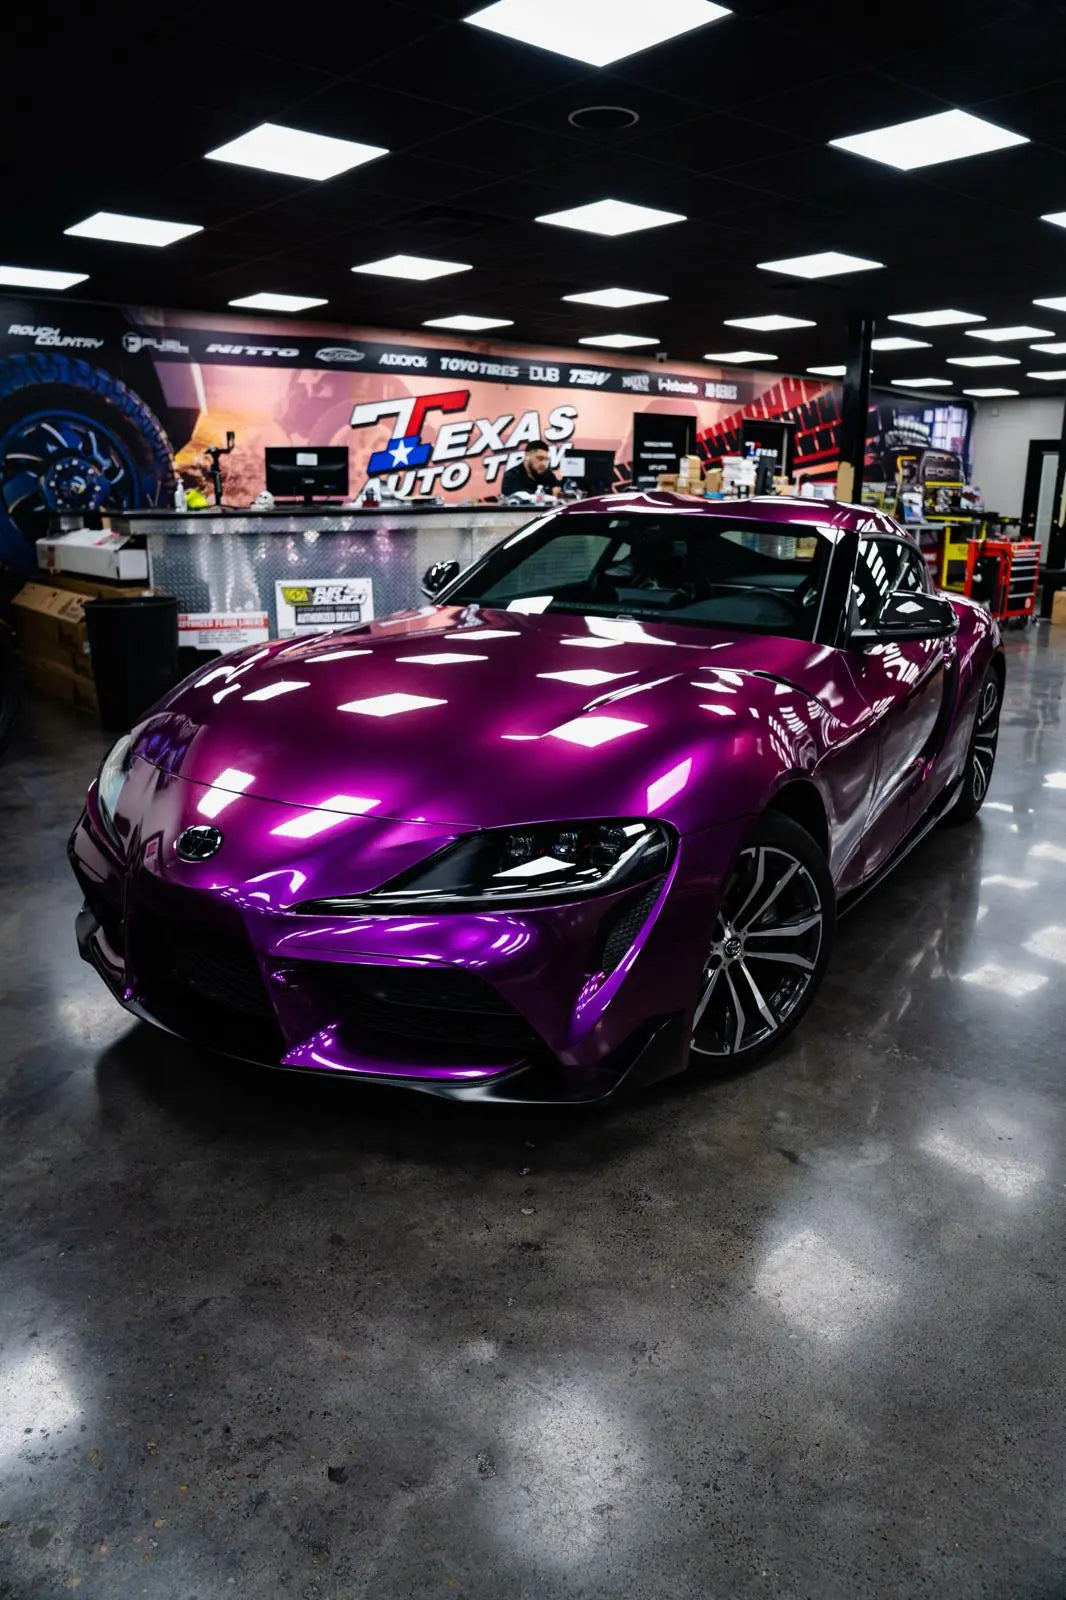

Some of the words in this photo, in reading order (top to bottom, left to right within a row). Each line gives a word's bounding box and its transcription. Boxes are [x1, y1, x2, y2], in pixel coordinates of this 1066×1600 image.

[8, 324, 61, 337] ROUGH
[35, 335, 104, 349] COUNTRY
[142, 337, 189, 353] FUEL
[205, 343, 300, 358] NITTO
[440, 357, 480, 374] TOYO
[479, 362, 520, 378] TIRES
[528, 365, 560, 383] DUB
[569, 369, 612, 386] TSW
[350, 389, 579, 474] TEXAS
